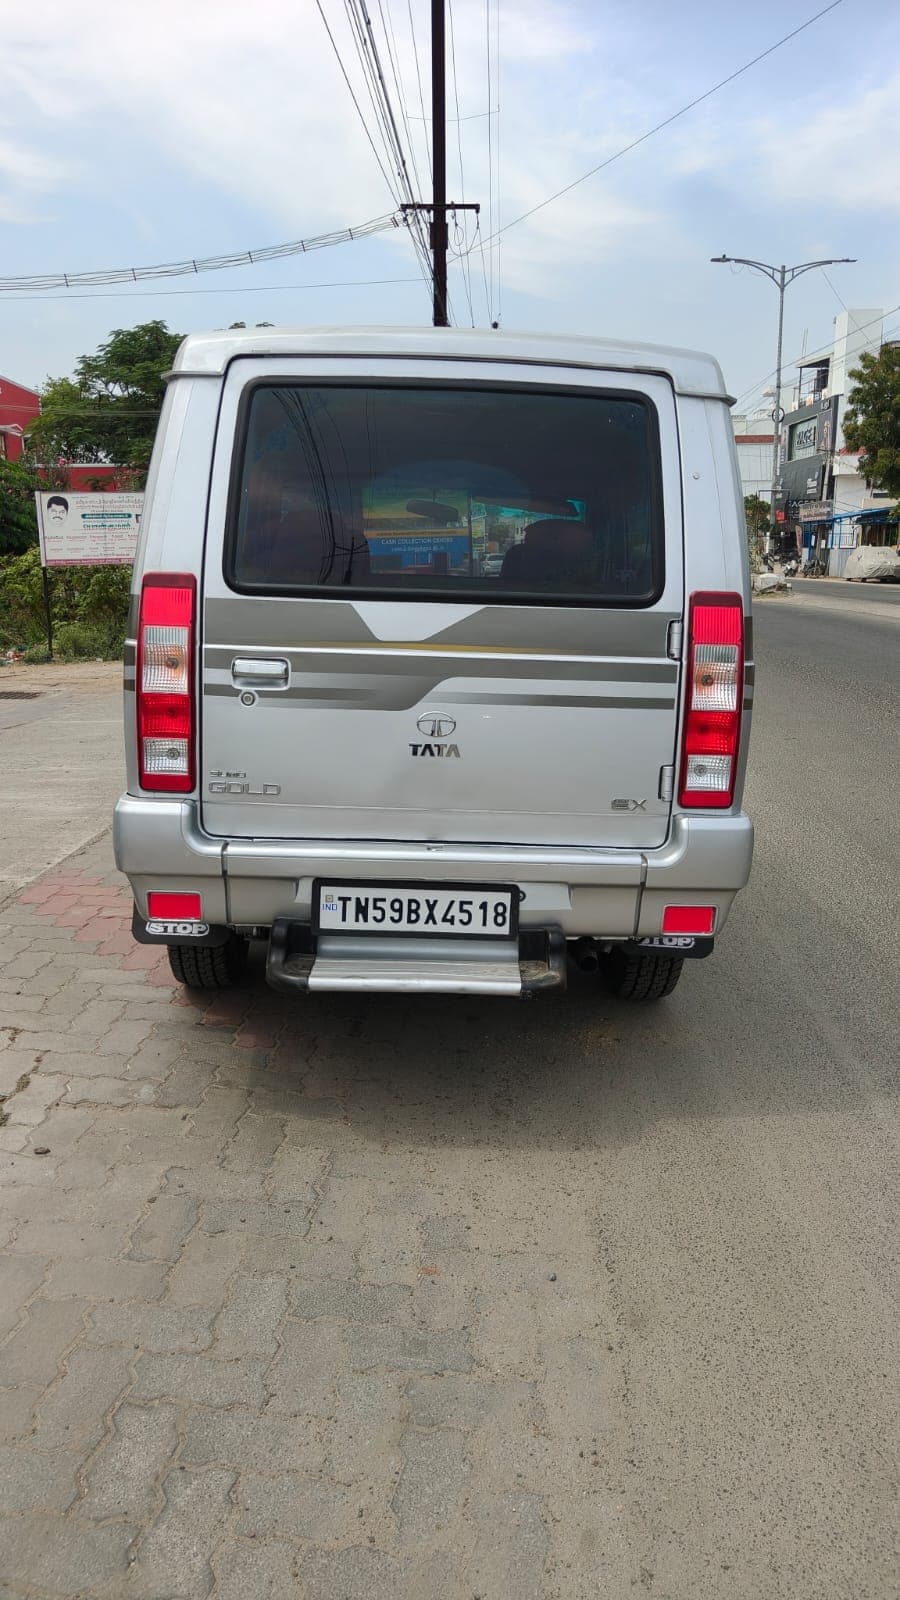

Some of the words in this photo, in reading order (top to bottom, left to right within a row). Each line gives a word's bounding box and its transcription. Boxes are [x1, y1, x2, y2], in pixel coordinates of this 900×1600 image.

[398, 537, 431, 545] COLLECTION
[408, 743, 461, 758] TATA
[208, 781, 281, 796] GOLD
[611, 798, 647, 811] EX
[322, 903, 338, 911] IND
[338, 896, 508, 928] TN59BX4518
[150, 922, 207, 935] STOP
